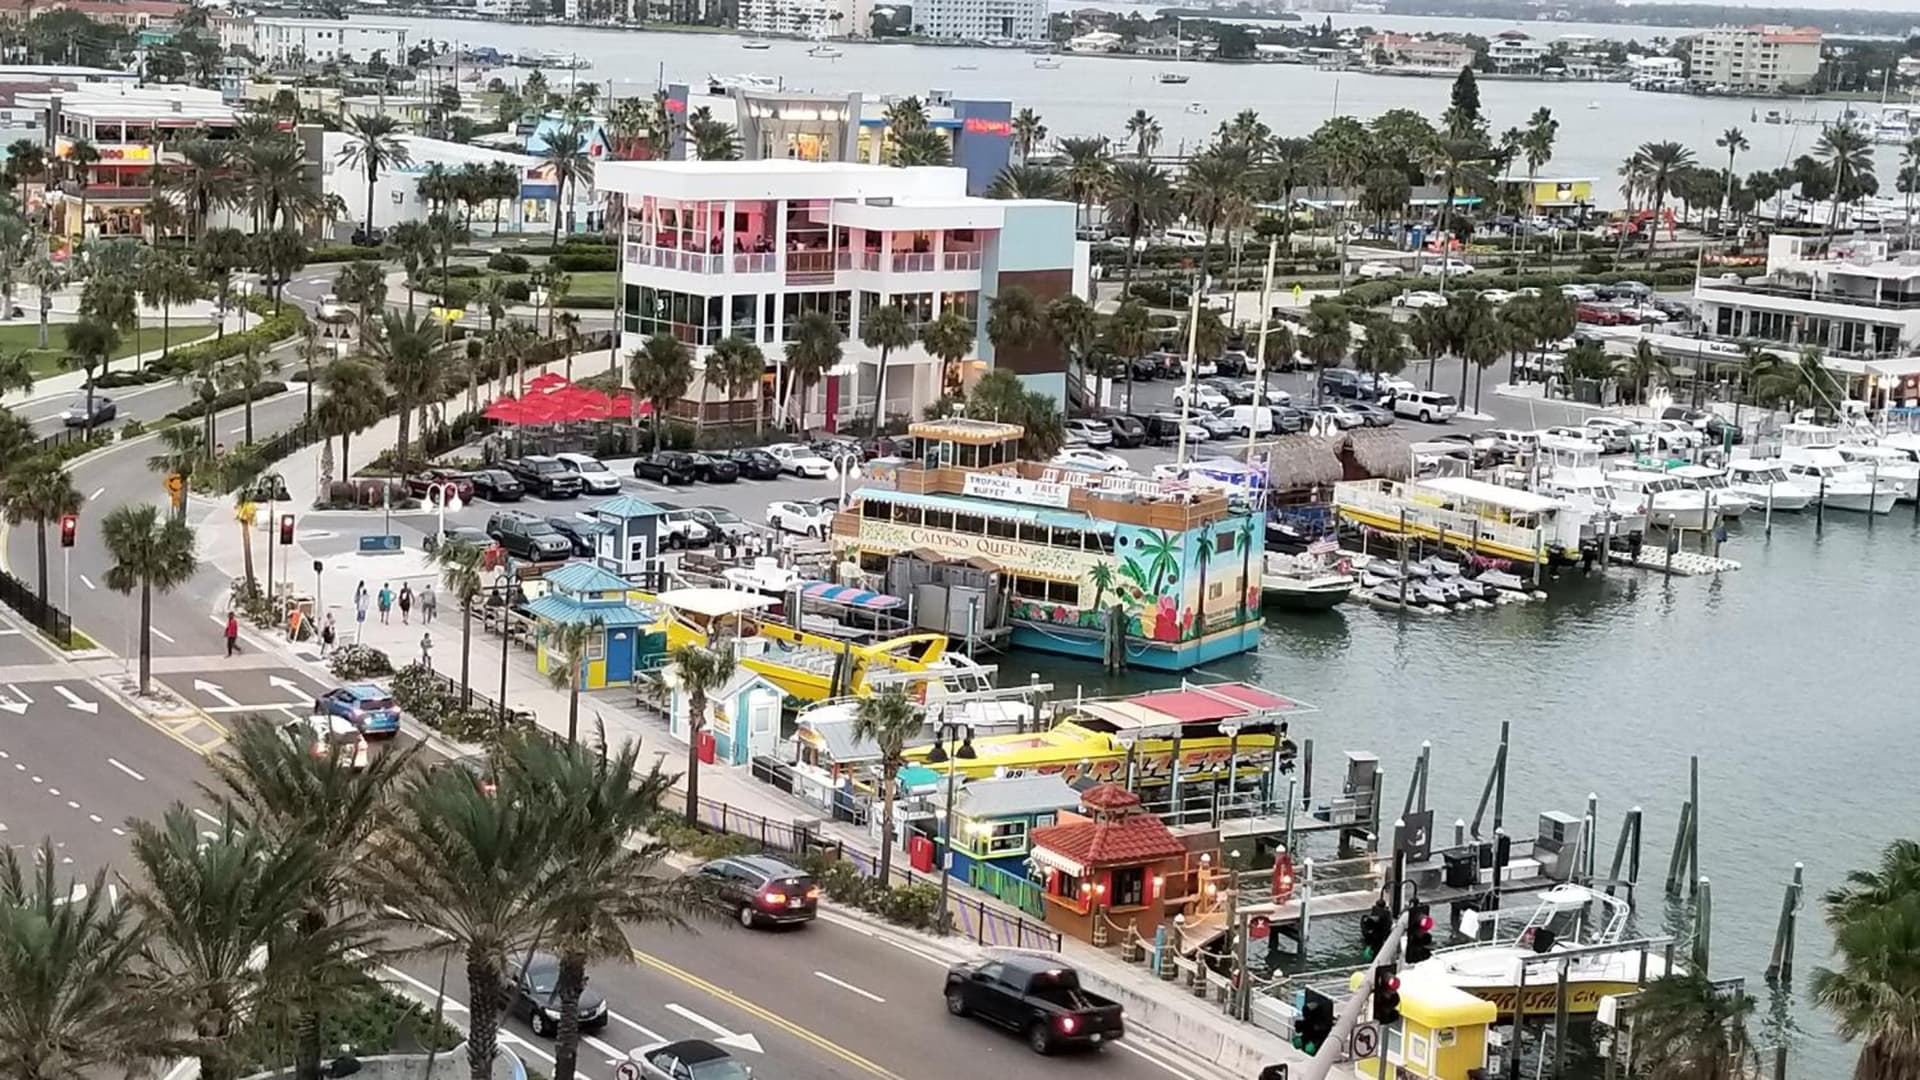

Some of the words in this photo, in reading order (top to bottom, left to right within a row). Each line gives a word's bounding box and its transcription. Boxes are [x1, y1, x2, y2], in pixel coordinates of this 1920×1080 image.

[970, 476, 1010, 489] TROPICAL
[973, 487, 1005, 497] BUFFET
[1034, 484, 1061, 494] FREE
